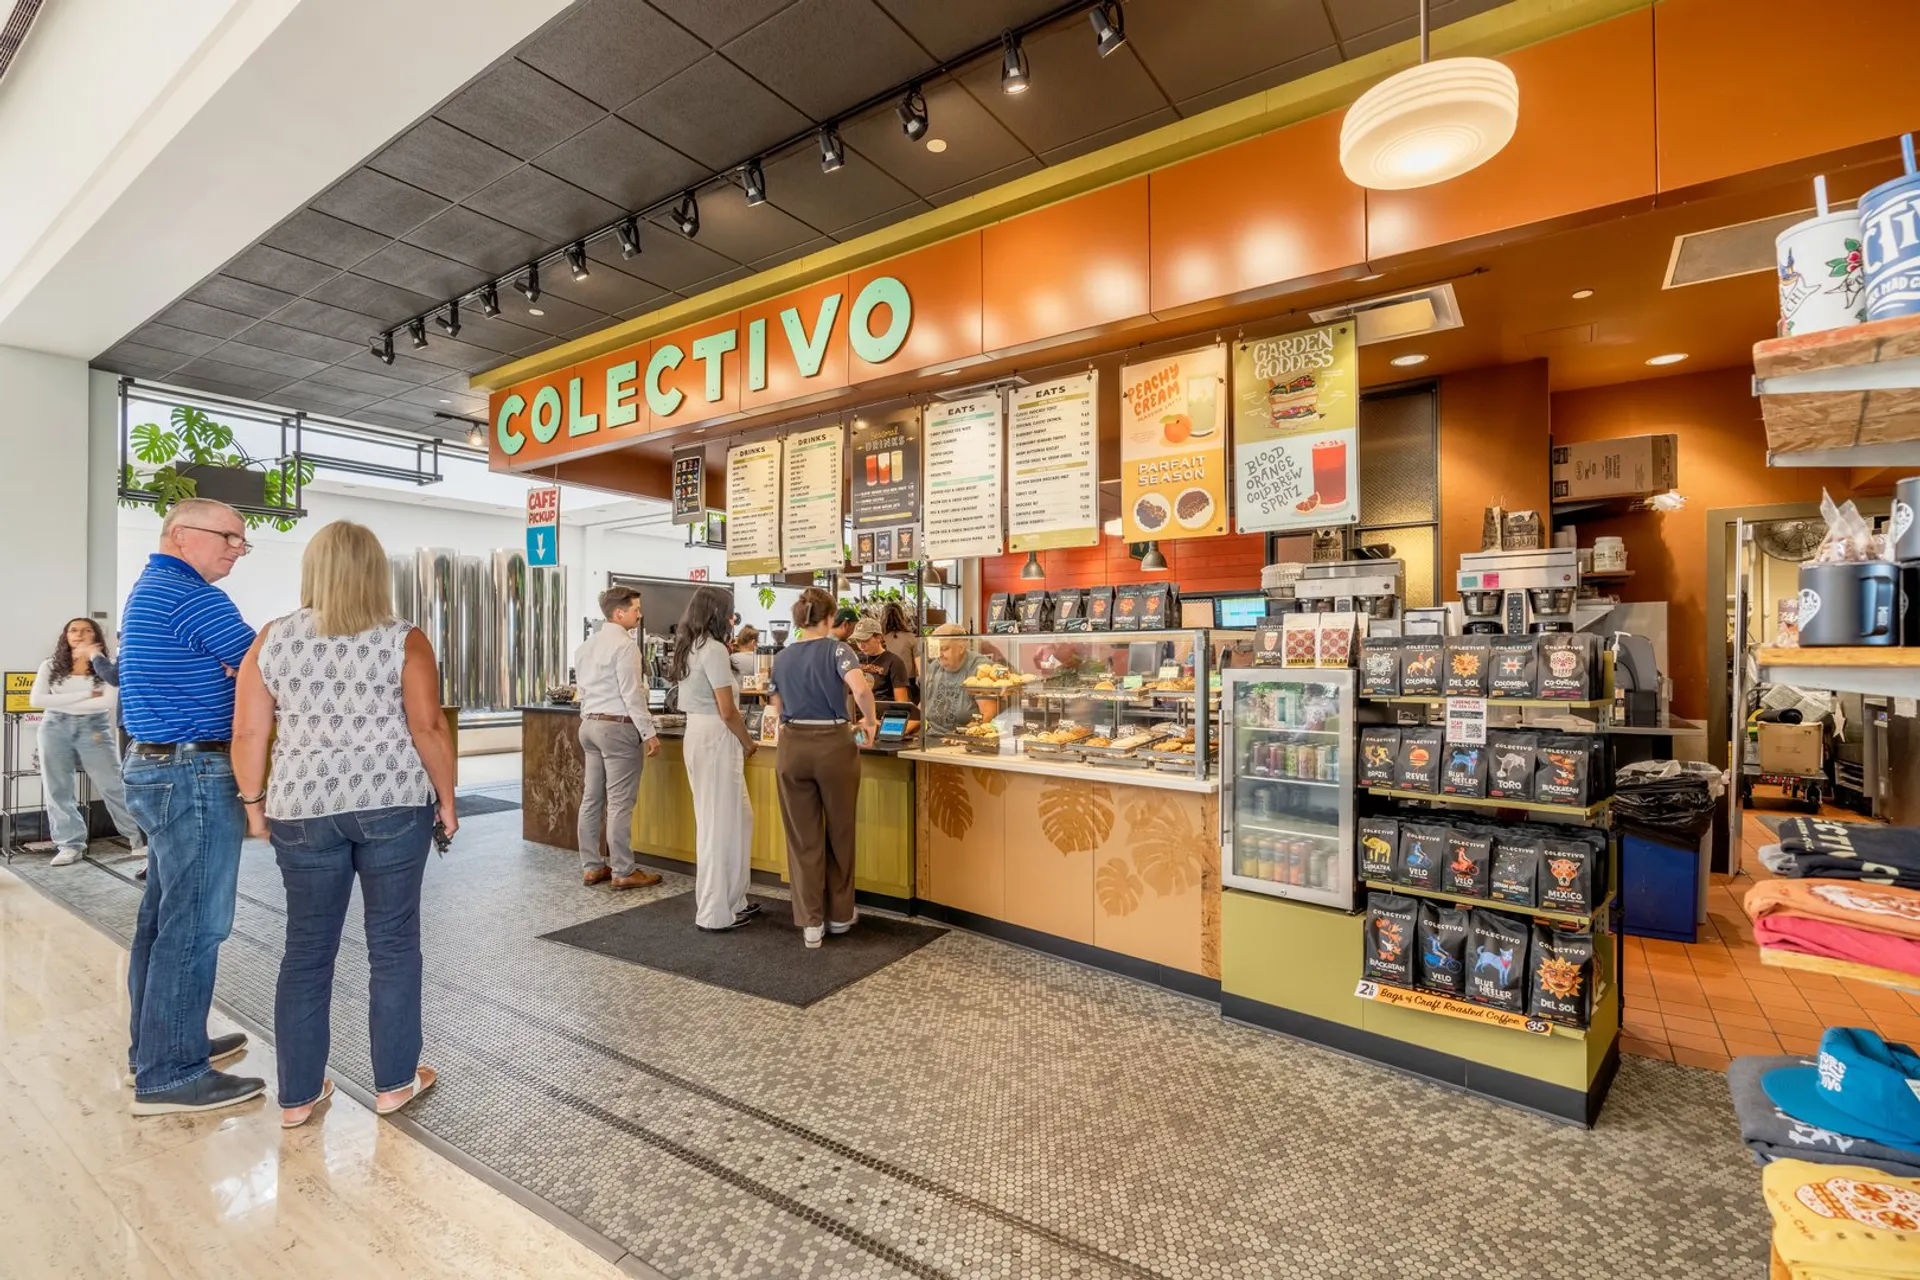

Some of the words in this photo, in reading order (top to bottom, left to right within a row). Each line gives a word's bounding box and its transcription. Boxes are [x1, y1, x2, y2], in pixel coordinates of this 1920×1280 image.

[1253, 328, 1334, 364] GARDEN
[497, 276, 912, 456] COLECTIVO
[1254, 351, 1335, 380] GODDESS
[1127, 363, 1180, 404] PEACHY
[1036, 386, 1066, 398] EATS
[1134, 382, 1180, 417] CREAM
[947, 404, 976, 416] EATS
[798, 434, 826, 446] DRINKS
[865, 435, 906, 452] DRINKS
[739, 446, 766, 458] DRINKS
[1138, 456, 1206, 474] PARFAIT
[1245, 446, 1284, 476] BLOOD
[1138, 469, 1205, 486] SEASON
[1246, 456, 1294, 490] ORANGE
[528, 490, 556, 510] CAFE
[1260, 484, 1302, 515] SPRITZ
[528, 510, 556, 524] PICKUP
[688, 568, 706, 580] APP
[1366, 677, 1391, 686] INDIGO
[1404, 678, 1436, 686] COLOMBIA
[1449, 678, 1462, 686] DEL
[1464, 678, 1480, 688] SOL
[1494, 680, 1529, 688] COLOMBIA
[1494, 743, 1532, 752] COLECTIVO
[1405, 772, 1430, 782] REVEL
[1452, 777, 1478, 786] HEELER
[1498, 780, 1522, 790] TORO
[1406, 832, 1440, 842] COLECTIVO
[1449, 838, 1485, 848] COLECTIVO
[1498, 844, 1534, 854] COLECTIVO
[1544, 850, 1584, 859] COLECTIVO
[1409, 868, 1428, 876] VELO
[1454, 876, 1474, 886] VELO
[1547, 890, 1582, 900] MEXICO
[1372, 908, 1412, 920] COLECTIVO
[1424, 920, 1464, 932] COLECTIVO
[1475, 928, 1521, 944] COLECTIVO
[1538, 941, 1586, 956] COLECTIVO
[1432, 972, 1452, 982] VELO
[1474, 977, 1494, 989] BLUE
[1479, 985, 1512, 1000] HEELER
[1358, 984, 1369, 995] 2
[1380, 988, 1404, 1003] Bags
[1414, 994, 1442, 1012] Craft
[1444, 1002, 1484, 1018] Roasted
[1486, 1010, 1520, 1026] Coffee
[1528, 1020, 1546, 1032] 35
[1540, 998, 1557, 1010] DEL
[1558, 1003, 1577, 1014] SOL
